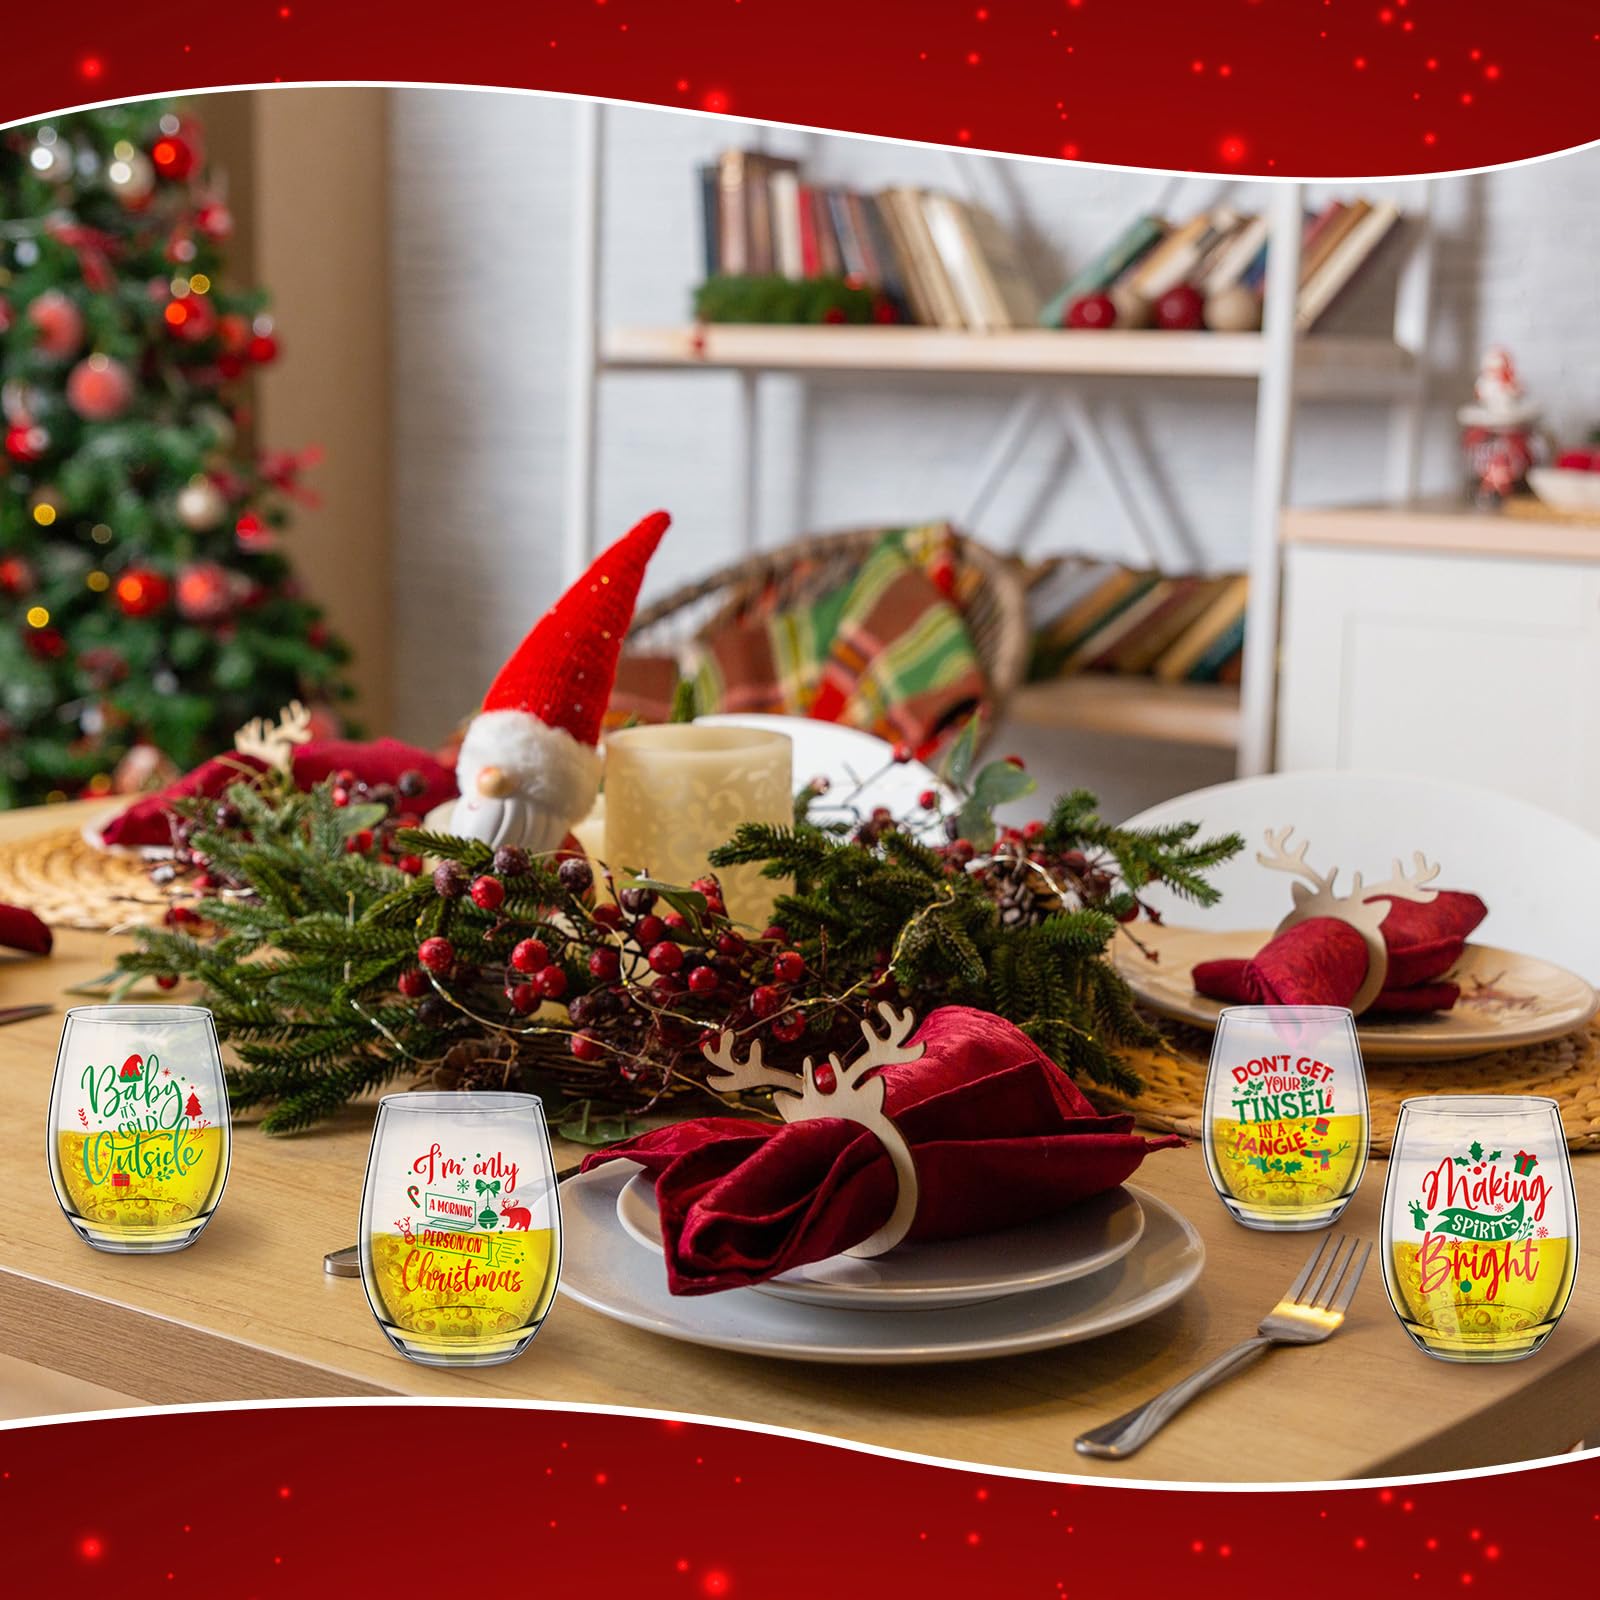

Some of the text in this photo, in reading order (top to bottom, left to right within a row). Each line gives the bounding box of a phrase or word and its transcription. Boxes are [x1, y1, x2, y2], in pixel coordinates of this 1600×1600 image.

[1231, 1055, 1335, 1084] DON'T GET
[81, 1054, 182, 1130] Baby
[1264, 1075, 1301, 1095] YOUR
[120, 1101, 136, 1119] IT'S
[1231, 1088, 1335, 1125] TINSEL
[118, 1116, 158, 1138] COLD
[1258, 1122, 1288, 1138] IN A
[83, 1117, 203, 1185] Outside
[1233, 1131, 1307, 1156] TANGLE
[413, 1143, 519, 1194] I'm only
[1422, 1156, 1553, 1221] Making
[428, 1199, 474, 1219] A MORNING
[422, 1230, 483, 1254] PERSON ON
[402, 1249, 524, 1293] Christmas
[1415, 1231, 1540, 1301] Bright
